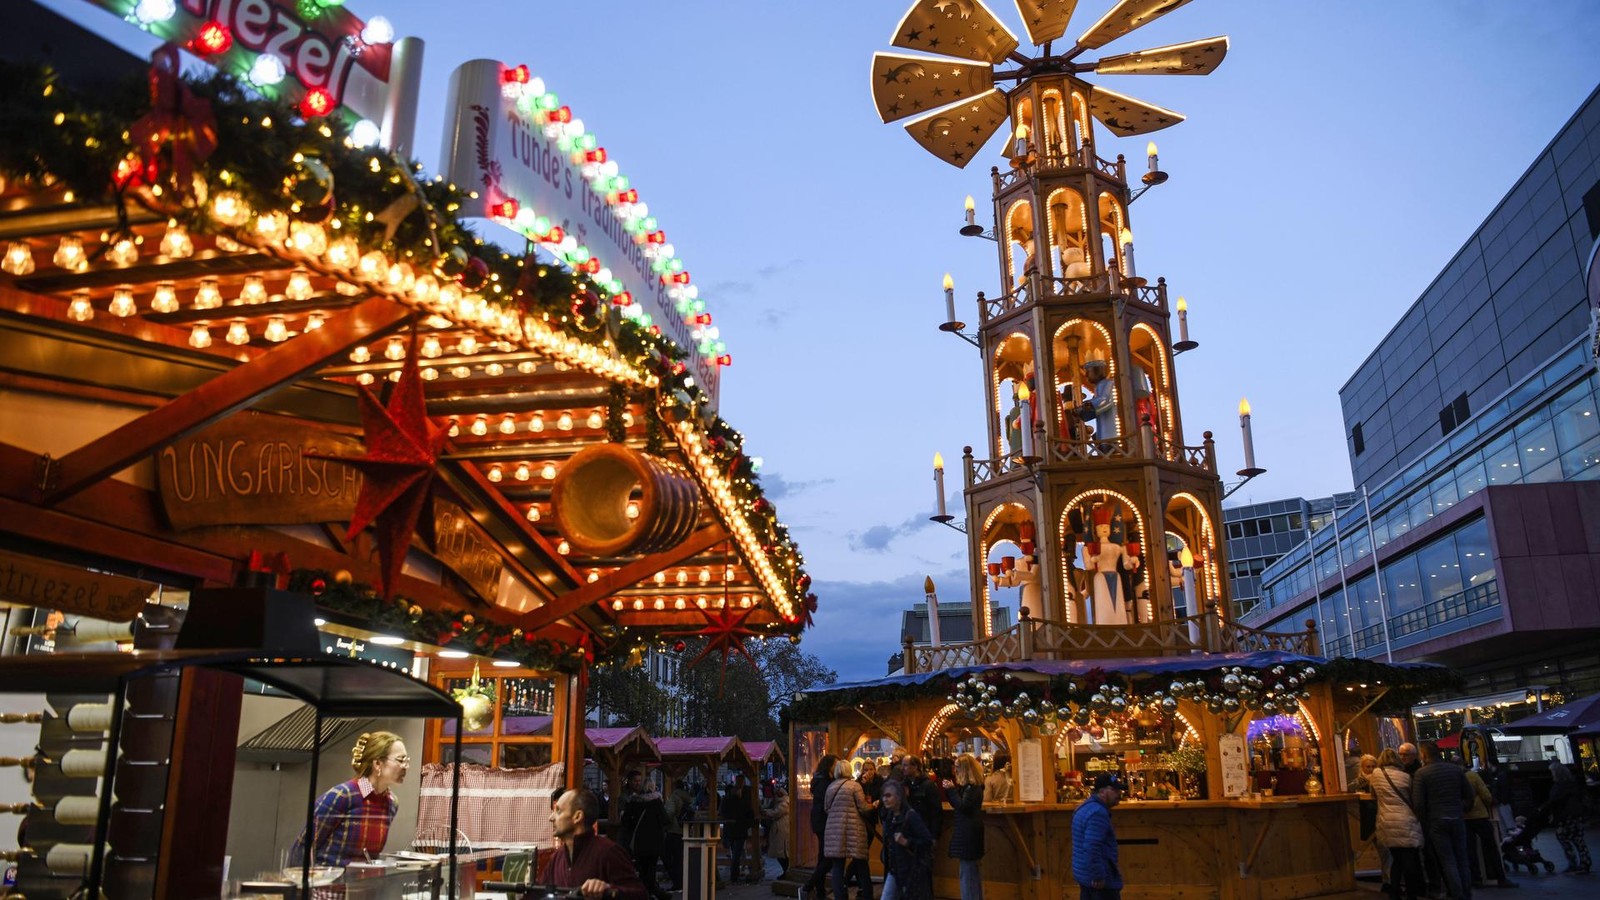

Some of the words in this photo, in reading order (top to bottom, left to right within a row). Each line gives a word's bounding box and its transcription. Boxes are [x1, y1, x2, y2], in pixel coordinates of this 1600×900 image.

[508, 111, 572, 199] Tünde's
[164, 440, 364, 502] UNGARISCH
[0, 560, 100, 601] triezel
